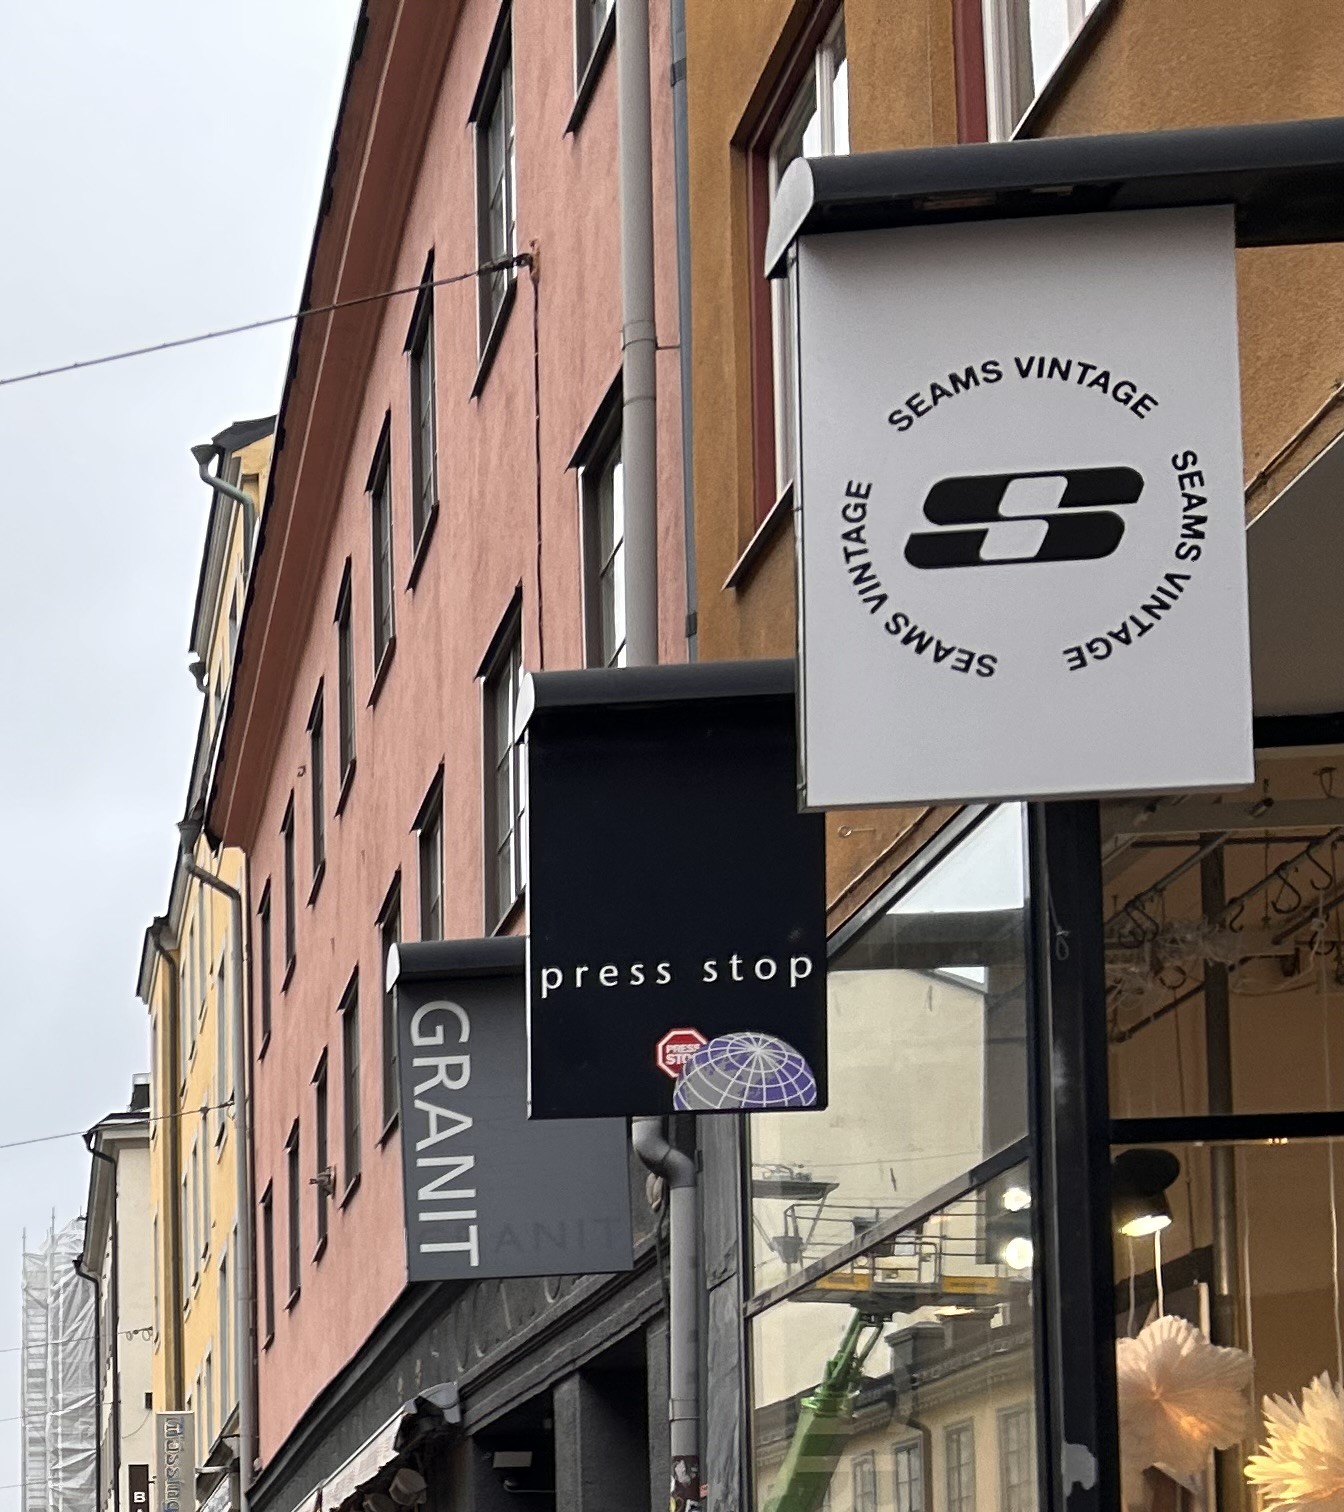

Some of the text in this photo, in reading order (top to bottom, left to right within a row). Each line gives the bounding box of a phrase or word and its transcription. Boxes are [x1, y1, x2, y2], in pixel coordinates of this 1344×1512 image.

[887, 355, 1159, 433] SEAMS VINTAGE
[841, 479, 999, 678] SEAMS VINTAGE
[1062, 449, 1208, 671] SEAMS VINTAGE
[541, 953, 813, 999] press stop
[410, 1000, 479, 1267] GRANIT
